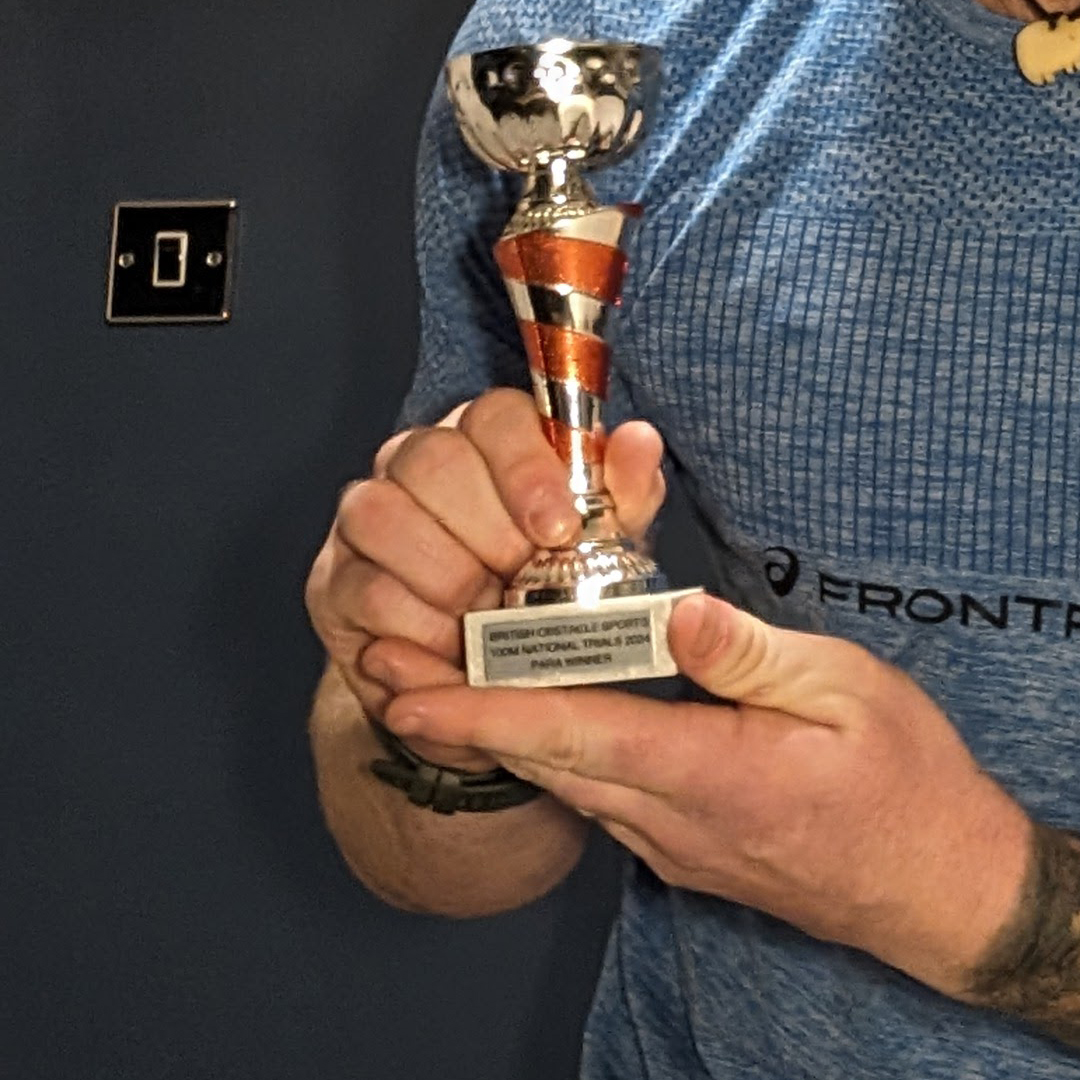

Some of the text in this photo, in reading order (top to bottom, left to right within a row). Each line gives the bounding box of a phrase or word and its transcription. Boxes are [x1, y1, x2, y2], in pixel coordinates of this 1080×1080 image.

[489, 628, 535, 641] BRITISH
[521, 641, 580, 654] NATIONAL
[565, 652, 613, 667] WINNER
